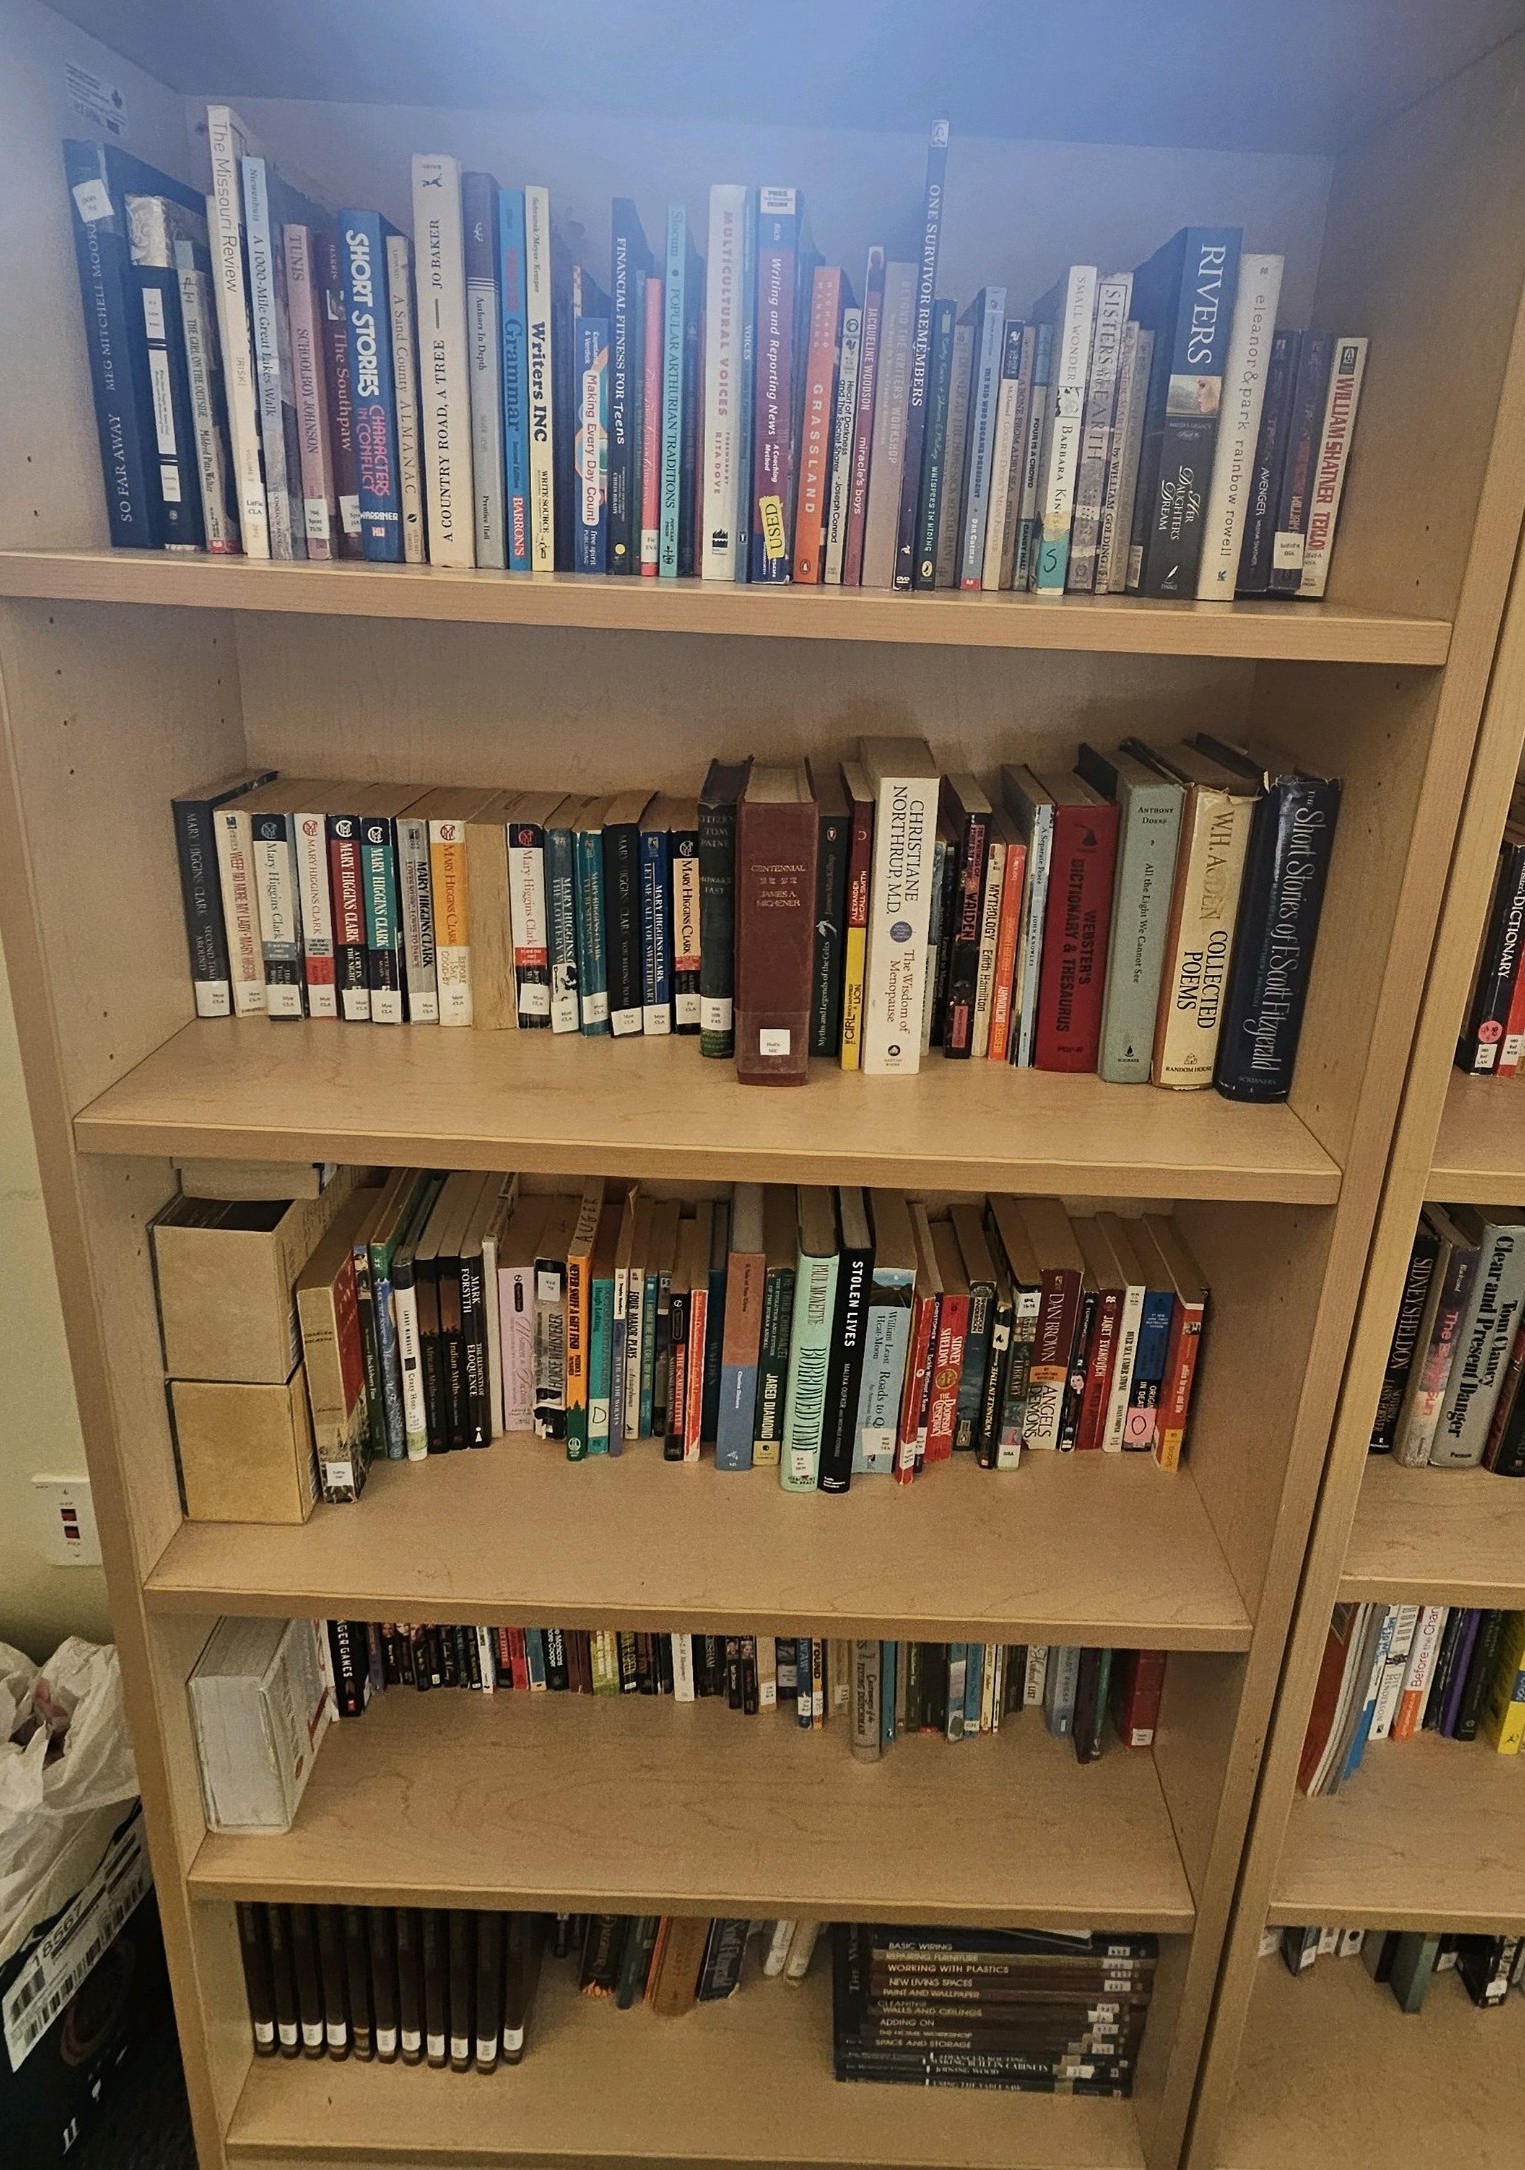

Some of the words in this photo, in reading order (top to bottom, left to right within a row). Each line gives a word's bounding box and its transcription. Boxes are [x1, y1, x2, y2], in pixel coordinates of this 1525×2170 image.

[212, 121, 230, 154] The
[215, 157, 237, 231] Missouri
[926, 184, 943, 219] ONE
[253, 235, 265, 245] A
[289, 234, 305, 281] TUNIS
[430, 219, 441, 268] BAKER
[223, 235, 240, 294] Review
[254, 249, 271, 313] 1000-Mile
[345, 230, 374, 307] SHORT
[431, 274, 442, 288] JO
[615, 237, 627, 313] FINANCIAL
[719, 210, 734, 350] MULTICULTURAL
[768, 258, 783, 306] Writing
[919, 223, 940, 305] SURVIVOR
[393, 295, 405, 305] A
[668, 288, 681, 350] POPULAR
[1186, 243, 1228, 364] RIVERS
[258, 316, 272, 348] Great
[394, 310, 408, 340] Sand
[615, 315, 627, 369] FITNESS
[769, 311, 781, 336] and
[863, 308, 878, 363] JACQUELINE
[259, 352, 275, 384] Lakes
[296, 328, 314, 397] SCHOOLBOY
[334, 333, 348, 362] The
[353, 310, 380, 396] STORIES
[434, 340, 446, 384] TREE
[531, 322, 547, 400] Writers
[766, 339, 780, 399] Reporting
[911, 309, 932, 407] REMEMBERS
[394, 347, 411, 392] County
[505, 319, 523, 431] Grammar
[615, 372, 626, 399] FOR
[717, 358, 729, 417] VOICES
[845, 380, 855, 401] Heart
[860, 365, 874, 411] WOODSON
[263, 388, 277, 416] Walk
[335, 367, 355, 451] Southpaw
[357, 407, 371, 418] IN
[436, 389, 447, 399] A
[584, 374, 598, 418] Making
[666, 353, 679, 431] ARTHURIAN
[844, 402, 853, 413] of
[1326, 378, 1356, 439] WILLIAM
[303, 400, 318, 454] JOHNSON
[437, 404, 449, 451] ROAD,
[534, 405, 548, 443] INC
[585, 423, 598, 455] Every
[613, 402, 626, 445] Teens
[767, 404, 780, 436] News
[841, 416, 851, 455] Darkness
[358, 421, 376, 492] CONFLICT
[370, 405, 391, 496] CHARACTERS
[399, 400, 416, 495] ALMANAC
[804, 384, 824, 515] GRASSLAND
[855, 437, 869, 485] miracle's
[438, 456, 451, 528] COUNTRY
[585, 460, 598, 482] Day
[665, 433, 678, 508] TRADITIONS
[1228, 440, 1248, 504] rainbow
[1256, 467, 1271, 515] AVENGER
[1316, 441, 1344, 504] SHATNER
[587, 486, 598, 521] Count
[852, 489, 865, 515] boys
[1158, 480, 1176, 530] DREAM
[1169, 465, 1195, 540] DAUGHTER'S
[1185, 493, 1200, 523] HER
[442, 531, 453, 542] A
[513, 496, 527, 556] BARRON'S
[766, 503, 783, 550] USED
[1221, 510, 1239, 556] rowell
[308, 839, 319, 867] MARY
[886, 785, 907, 878] NORTHRUP,
[904, 799, 925, 902] CHRISTIANE
[1288, 807, 1326, 858] Short
[264, 843, 278, 870] Mary
[339, 842, 355, 869] MARY
[370, 848, 385, 874] MARY
[521, 849, 535, 875] Mary
[681, 860, 693, 887] MARY
[1144, 863, 1155, 876] All
[266, 872, 281, 911] Higgins
[309, 867, 320, 905] HIGGINS
[342, 871, 357, 910] HIGGINS
[372, 876, 388, 915] HIGGINS
[523, 878, 536, 917] Higgins
[682, 888, 693, 924] HIGGINS
[885, 884, 904, 915] M.D.
[1065, 858, 1085, 939] DICTIONARY
[1138, 894, 1152, 917] Light
[1143, 879, 1153, 892] the
[1278, 860, 1316, 919] Stories
[272, 913, 285, 939] Clark
[312, 905, 322, 935] CLARK
[345, 912, 360, 942] CLARK
[374, 917, 389, 947] CLARK
[525, 918, 537, 945] Clark
[962, 891, 979, 938] WALDEN
[984, 884, 1000, 940] MYTHOLOGY
[1137, 919, 1148, 933] We
[1272, 923, 1302, 944] of
[682, 925, 694, 954] CLARK
[1064, 944, 1077, 953] &
[1079, 910, 1098, 985] WEBSTER'S
[1134, 936, 1146, 966] Cannot
[1498, 896, 1525, 978] DICTIONARY
[901, 950, 916, 972] The
[1133, 969, 1143, 984] See
[1177, 951, 1204, 1010] POEMS
[1197, 931, 1229, 1029] COLLECTED
[885, 960, 901, 1023] Menopause
[898, 973, 915, 1017] Wisdom
[1055, 959, 1077, 1032] THESAURUS
[899, 1019, 911, 1034] of
[1242, 1001, 1290, 1070] Fitzgerald
[1406, 1257, 1434, 1304] SIDNEY
[1487, 1236, 1515, 1282] Clear
[461, 1268, 473, 1313] FORSYTH
[471, 1275, 481, 1304] MARK
[848, 1261, 864, 1307] STOLEN
[1478, 1282, 1502, 1314] and
[885, 1311, 898, 1341] William
[1047, 1293, 1065, 1320] DAN
[1496, 1300, 1519, 1331] Tom
[844, 1312, 858, 1347] LIVES
[872, 1315, 885, 1359] Heat-Moon
[1041, 1321, 1060, 1362] BROWN
[1389, 1306, 1421, 1370] SHELDON
[1462, 1317, 1494, 1378] Present
[466, 1344, 478, 1397] ELOQUENCE
[883, 1343, 893, 1364] Least
[1477, 1335, 1512, 1388] Clancy
[763, 1373, 779, 1400] JARED
[794, 1347, 827, 1420] BORROWED
[876, 1370, 891, 1401] Roads
[761, 1401, 777, 1438] DIAMOND
[876, 1404, 886, 1414] to
[1023, 1384, 1043, 1438] DEMONS
[1037, 1385, 1058, 1438] ANGELS
[1445, 1382, 1481, 1438] Danger
[340, 1648, 352, 1678] GAMES
[813, 1642, 822, 1680] FOUND
[1410, 1652, 1430, 1687] Before
[888, 1942, 914, 1951] BASIC
[917, 1943, 952, 1952] WIRING
[887, 1964, 936, 1974] WORKING
[939, 1965, 963, 1974] WITH
[965, 1965, 1009, 1975] PLASTICS
[879, 2018, 916, 2027] ADDING
[919, 2018, 935, 2027] ON
